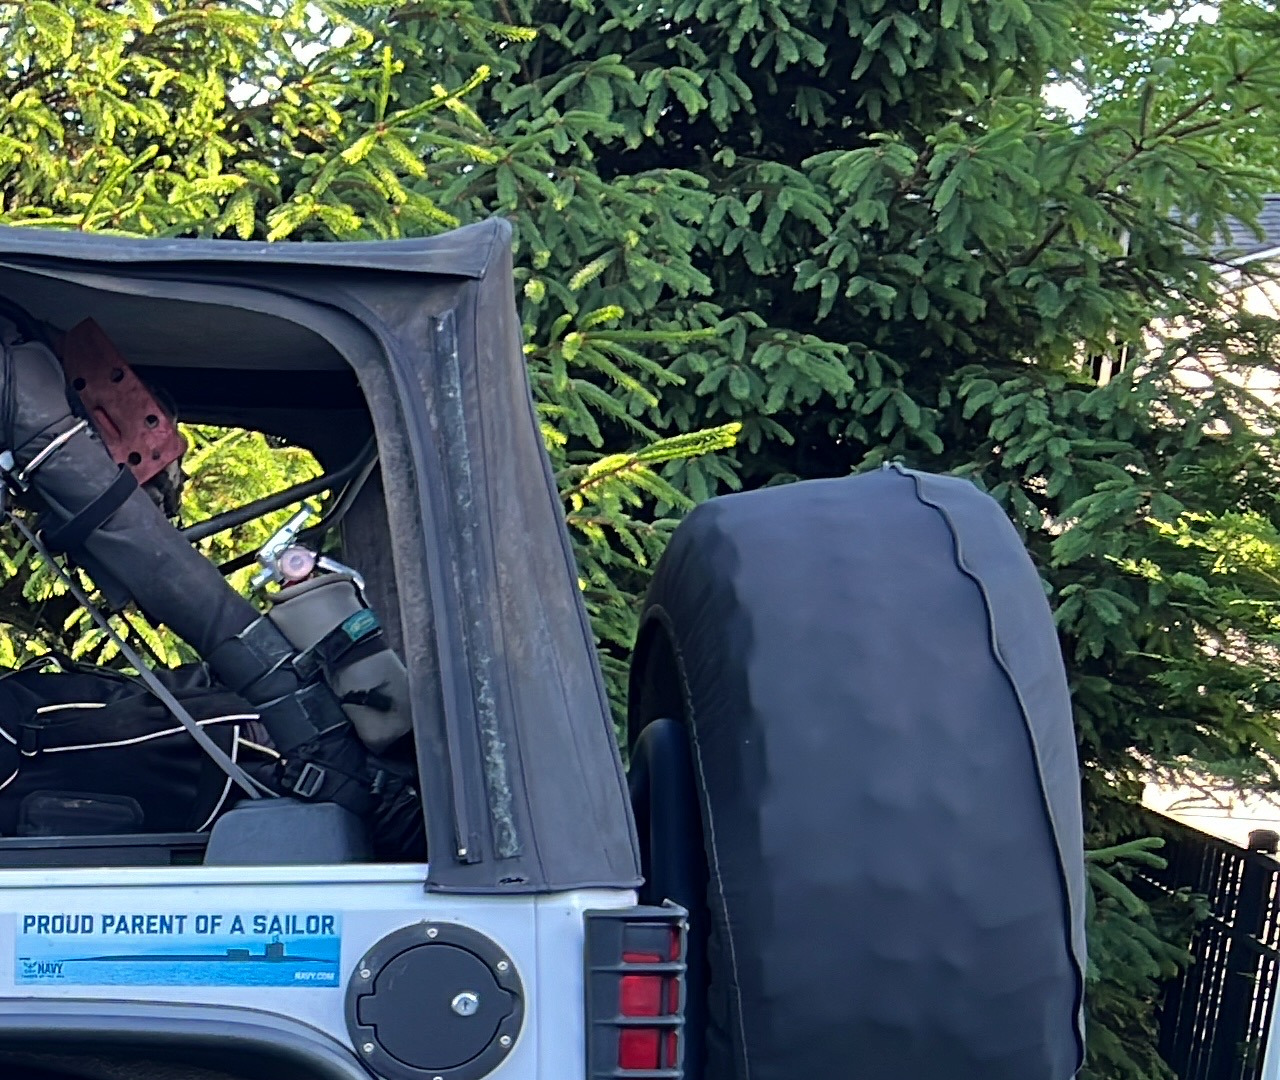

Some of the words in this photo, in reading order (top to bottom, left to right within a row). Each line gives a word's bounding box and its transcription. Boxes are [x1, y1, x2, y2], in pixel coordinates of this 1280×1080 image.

[23, 914, 94, 934] PROUD
[101, 914, 188, 934] PARENT
[195, 914, 222, 934] OF
[229, 915, 246, 935] A
[253, 914, 336, 935] SAILOR
[37, 962, 64, 975] NAVY
[293, 972, 336, 981] NAVY.COM
